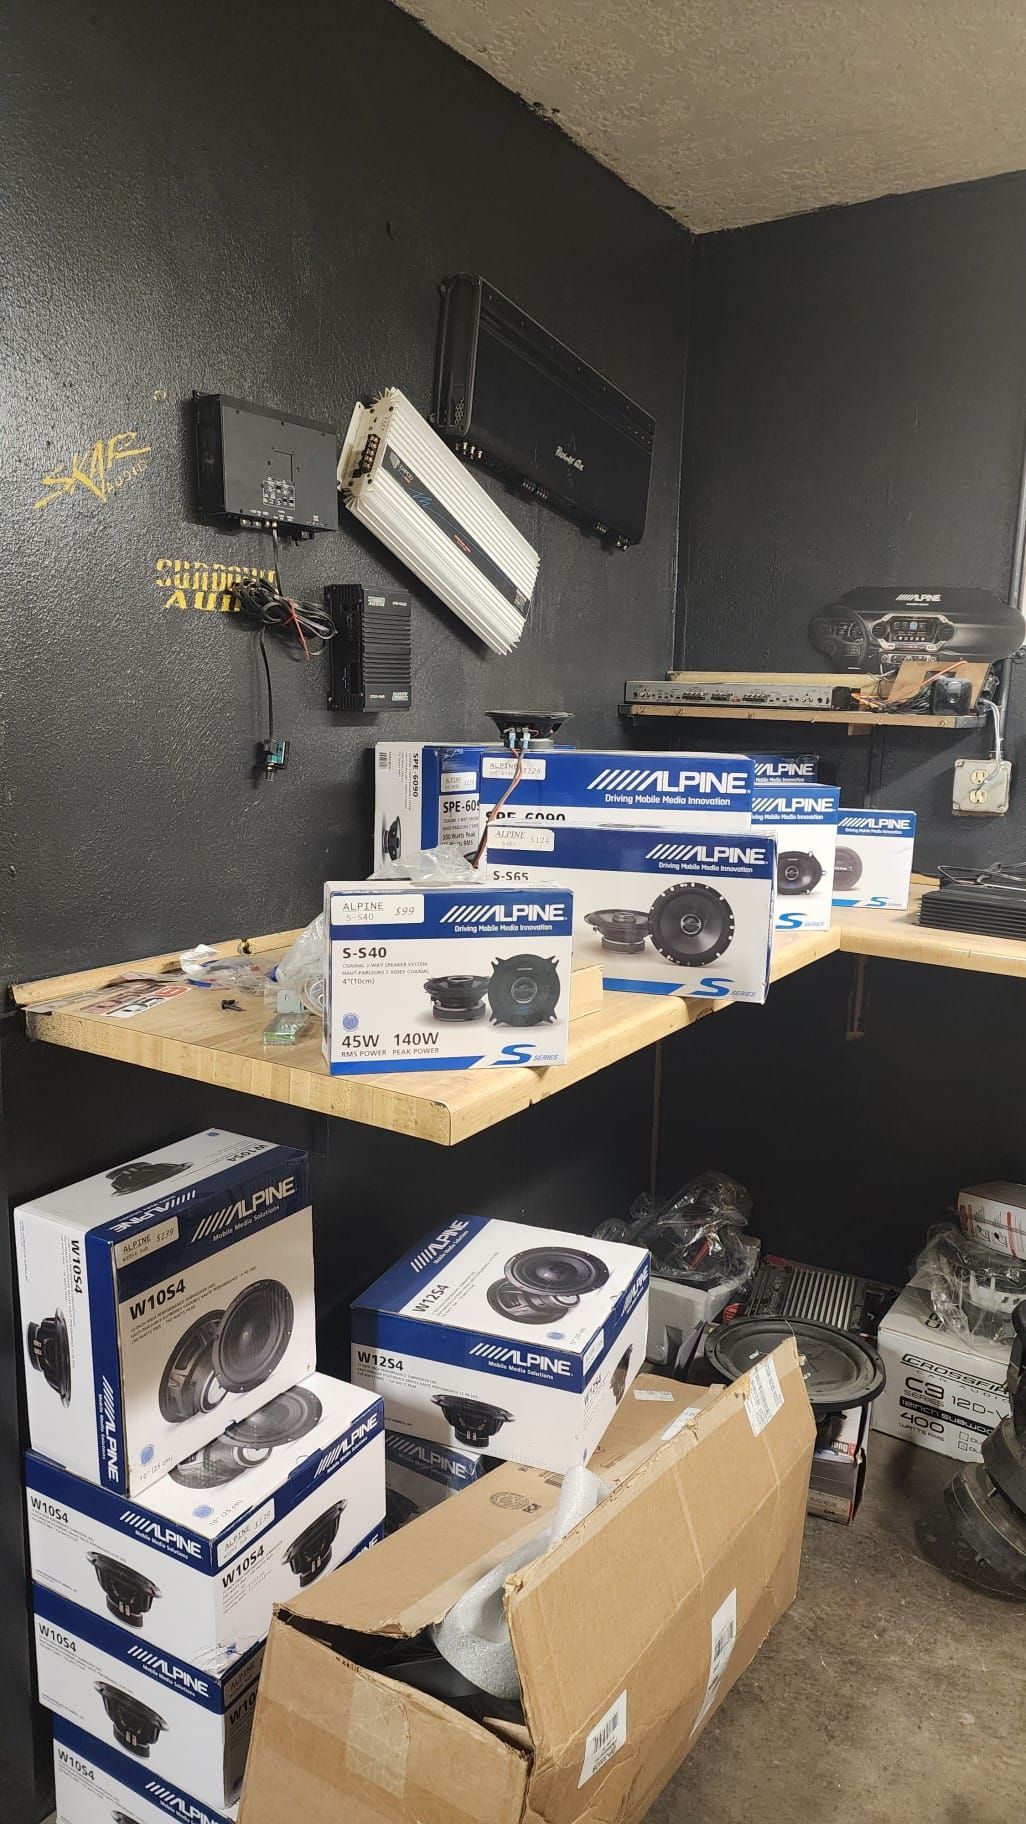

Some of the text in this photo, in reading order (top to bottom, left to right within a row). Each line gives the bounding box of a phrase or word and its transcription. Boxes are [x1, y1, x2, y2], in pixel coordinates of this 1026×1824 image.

[912, 594, 942, 602] ALPINE
[757, 763, 814, 776] ALPINE
[640, 770, 748, 794] ALPINE
[605, 793, 731, 806] Driving Mobile Media Innovation
[769, 798, 835, 812] ALPINE
[751, 813, 764, 821] iving
[861, 818, 910, 830] ALPINE
[495, 830, 526, 839] ALPINE
[686, 845, 766, 865] ALPINE
[493, 870, 529, 881] S-S65
[658, 861, 753, 873] Driving Mobile Media Innovation
[342, 902, 415, 916] ALPINE $99
[346, 913, 374, 921] S-S40
[482, 904, 565, 922] ALPINE
[454, 924, 477, 933] Driving
[478, 924, 499, 932] Mobile
[519, 923, 553, 931] Innovation
[342, 947, 387, 959] S-S40
[685, 977, 756, 998] S SERIES
[342, 1032, 440, 1048] 45W 140W
[491, 1043, 559, 1065] S SERIES
[225, 1176, 295, 1226] ALPINE
[107, 1202, 169, 1233] ALPINE
[213, 1205, 280, 1242] Mobile Media Solutions
[123, 1234, 152, 1253] ALPINE
[428, 1220, 470, 1256] ALPINE
[70, 1239, 83, 1295] W10S4
[129, 1278, 186, 1321] W10S4
[412, 1284, 449, 1313] W12S4
[357, 1350, 404, 1371] W12S4
[488, 1360, 554, 1380] Mobile Media Solutions
[501, 1349, 571, 1377] ALPINE
[903, 1354, 1010, 1396] CROSSFIR
[905, 1376, 945, 1400] C3
[900, 1411, 945, 1434] 400
[104, 1408, 119, 1483] ALPINE
[334, 1412, 378, 1460] ALPINE
[408, 1445, 467, 1480] ALPINE
[30, 1494, 69, 1524] W10S4
[135, 1529, 189, 1560] Mobile Media Solutions
[144, 1520, 203, 1560] ALPINE
[221, 1544, 265, 1588] W10S4
[38, 1622, 77, 1652] W10S4
[142, 1663, 158, 1676] Mobile
[158, 1673, 173, 1685] Media
[151, 1659, 209, 1698] ALPINE
[229, 1691, 257, 1725] W10
[57, 1747, 96, 1781] W10S4
[169, 1798, 220, 1824] ALPIN
